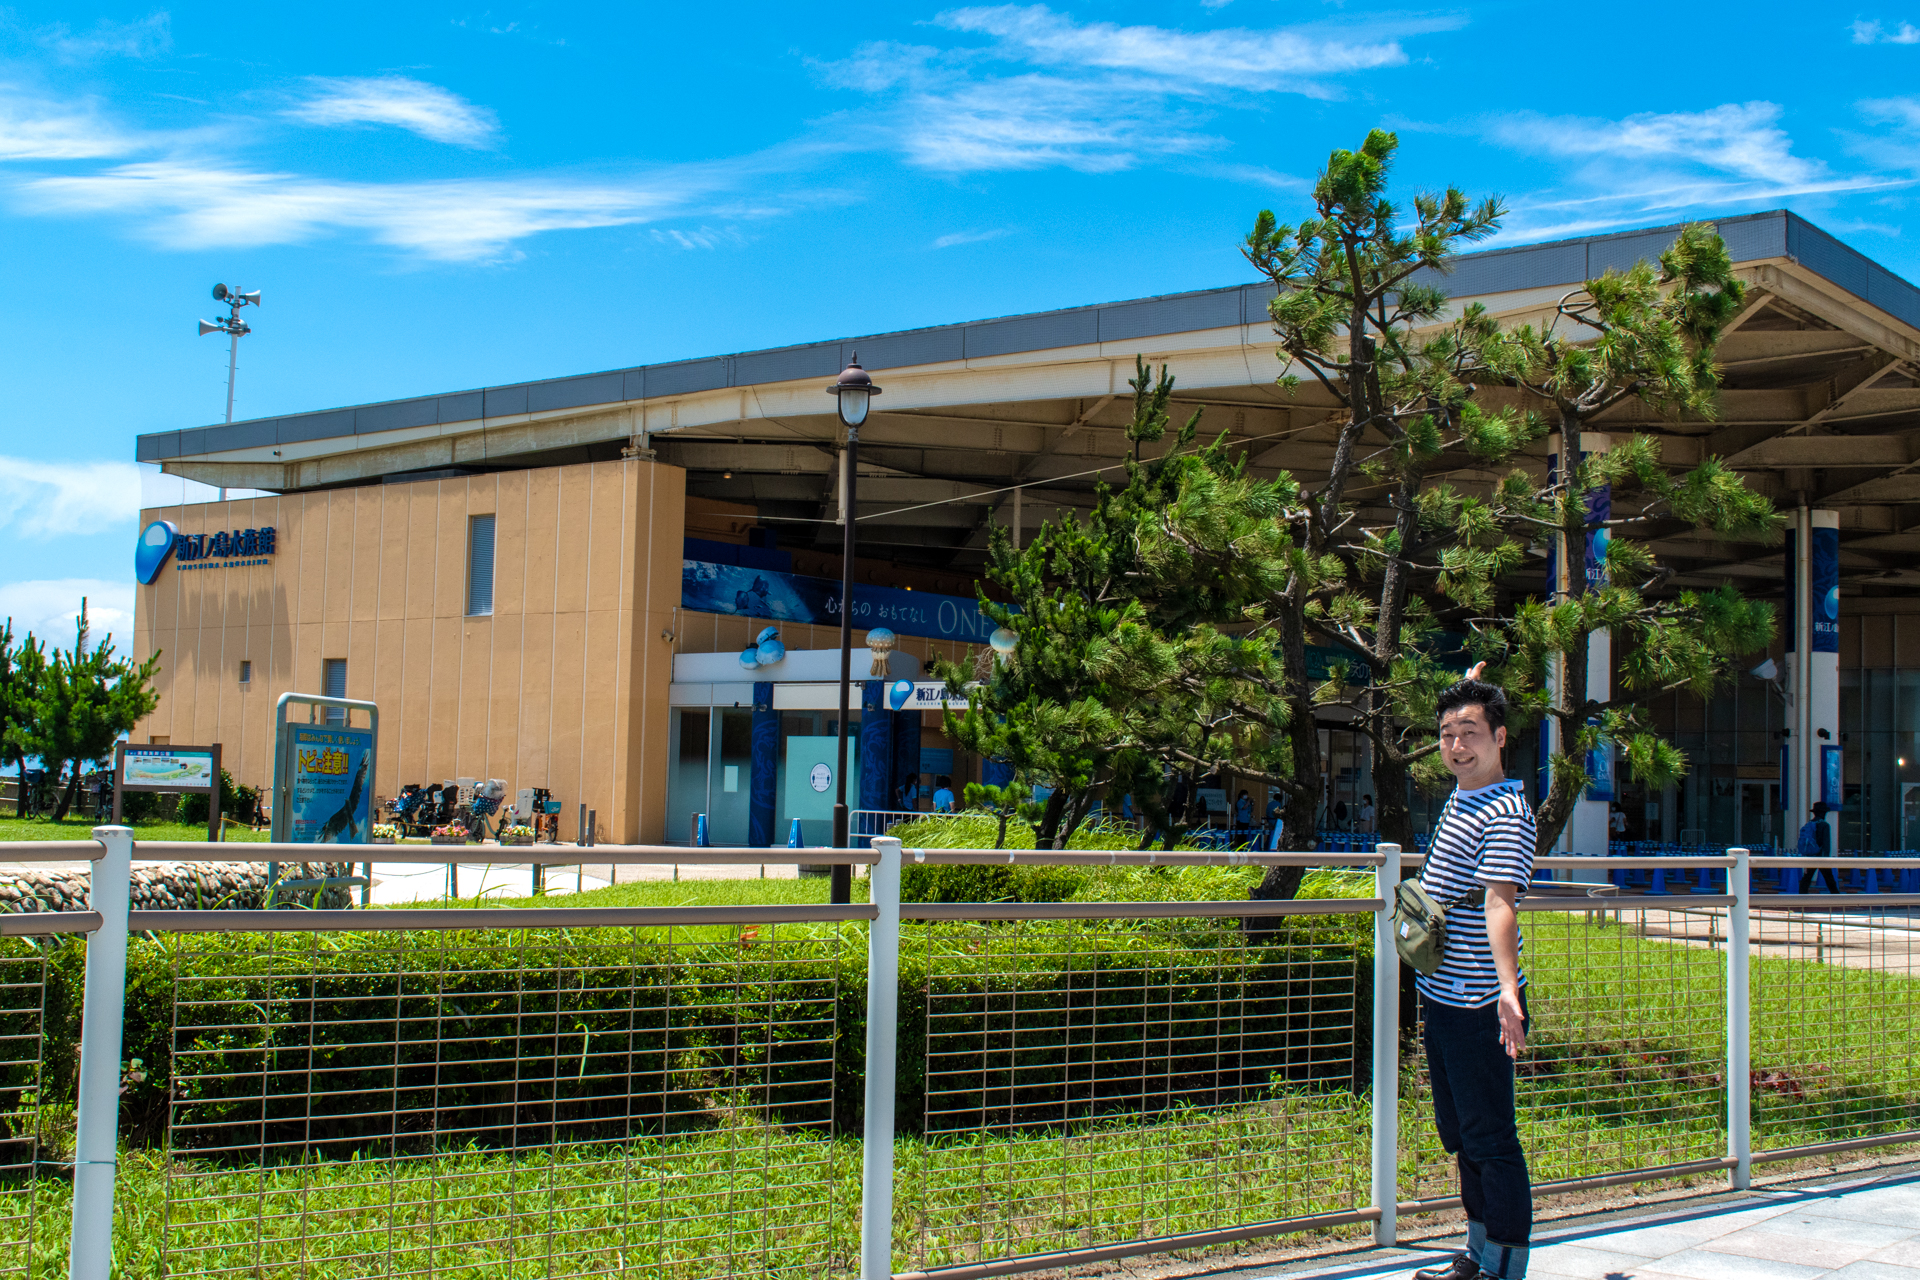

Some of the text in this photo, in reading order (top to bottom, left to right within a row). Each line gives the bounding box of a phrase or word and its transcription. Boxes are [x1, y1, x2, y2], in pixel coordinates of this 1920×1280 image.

[176, 527, 276, 561] 新江ノ島水族館
[879, 604, 927, 623] おもてなし
